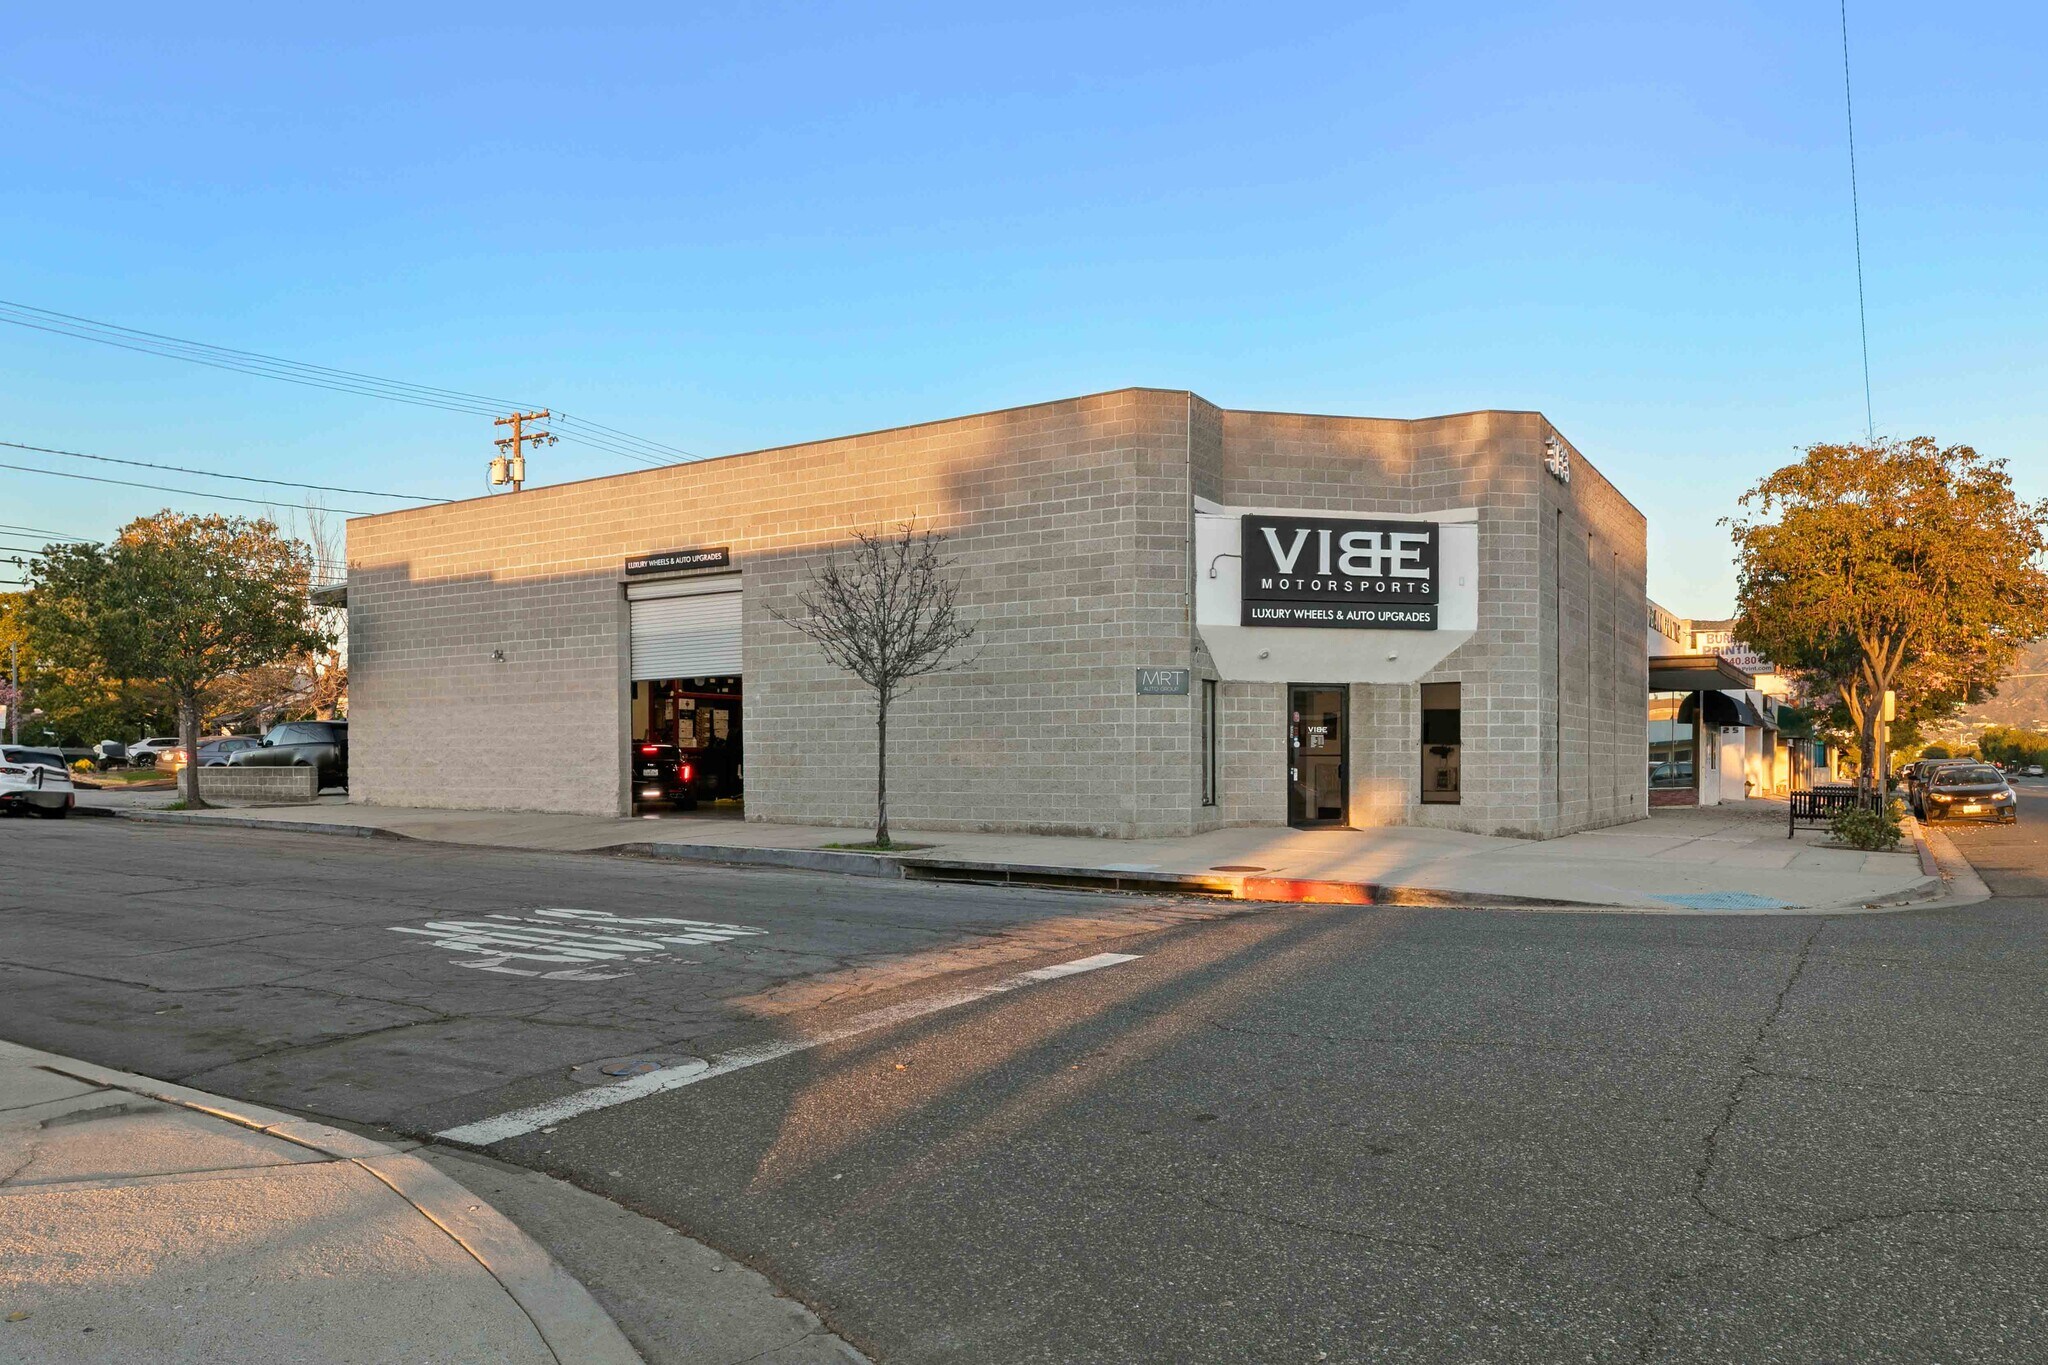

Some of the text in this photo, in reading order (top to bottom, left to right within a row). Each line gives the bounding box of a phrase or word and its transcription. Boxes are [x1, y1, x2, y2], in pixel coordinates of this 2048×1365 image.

[628, 561, 648, 569] LUXURY
[649, 558, 669, 566] WHEELS
[675, 555, 691, 564] AUTO
[692, 553, 722, 562] UPGRADES
[1260, 527, 1430, 580] VIBE
[1261, 578, 1430, 594] MOTORSPORTS
[1252, 608, 1431, 622] LUXURY WHEELS & AUTO UPGRADES
[1142, 671, 1184, 685] MRT
